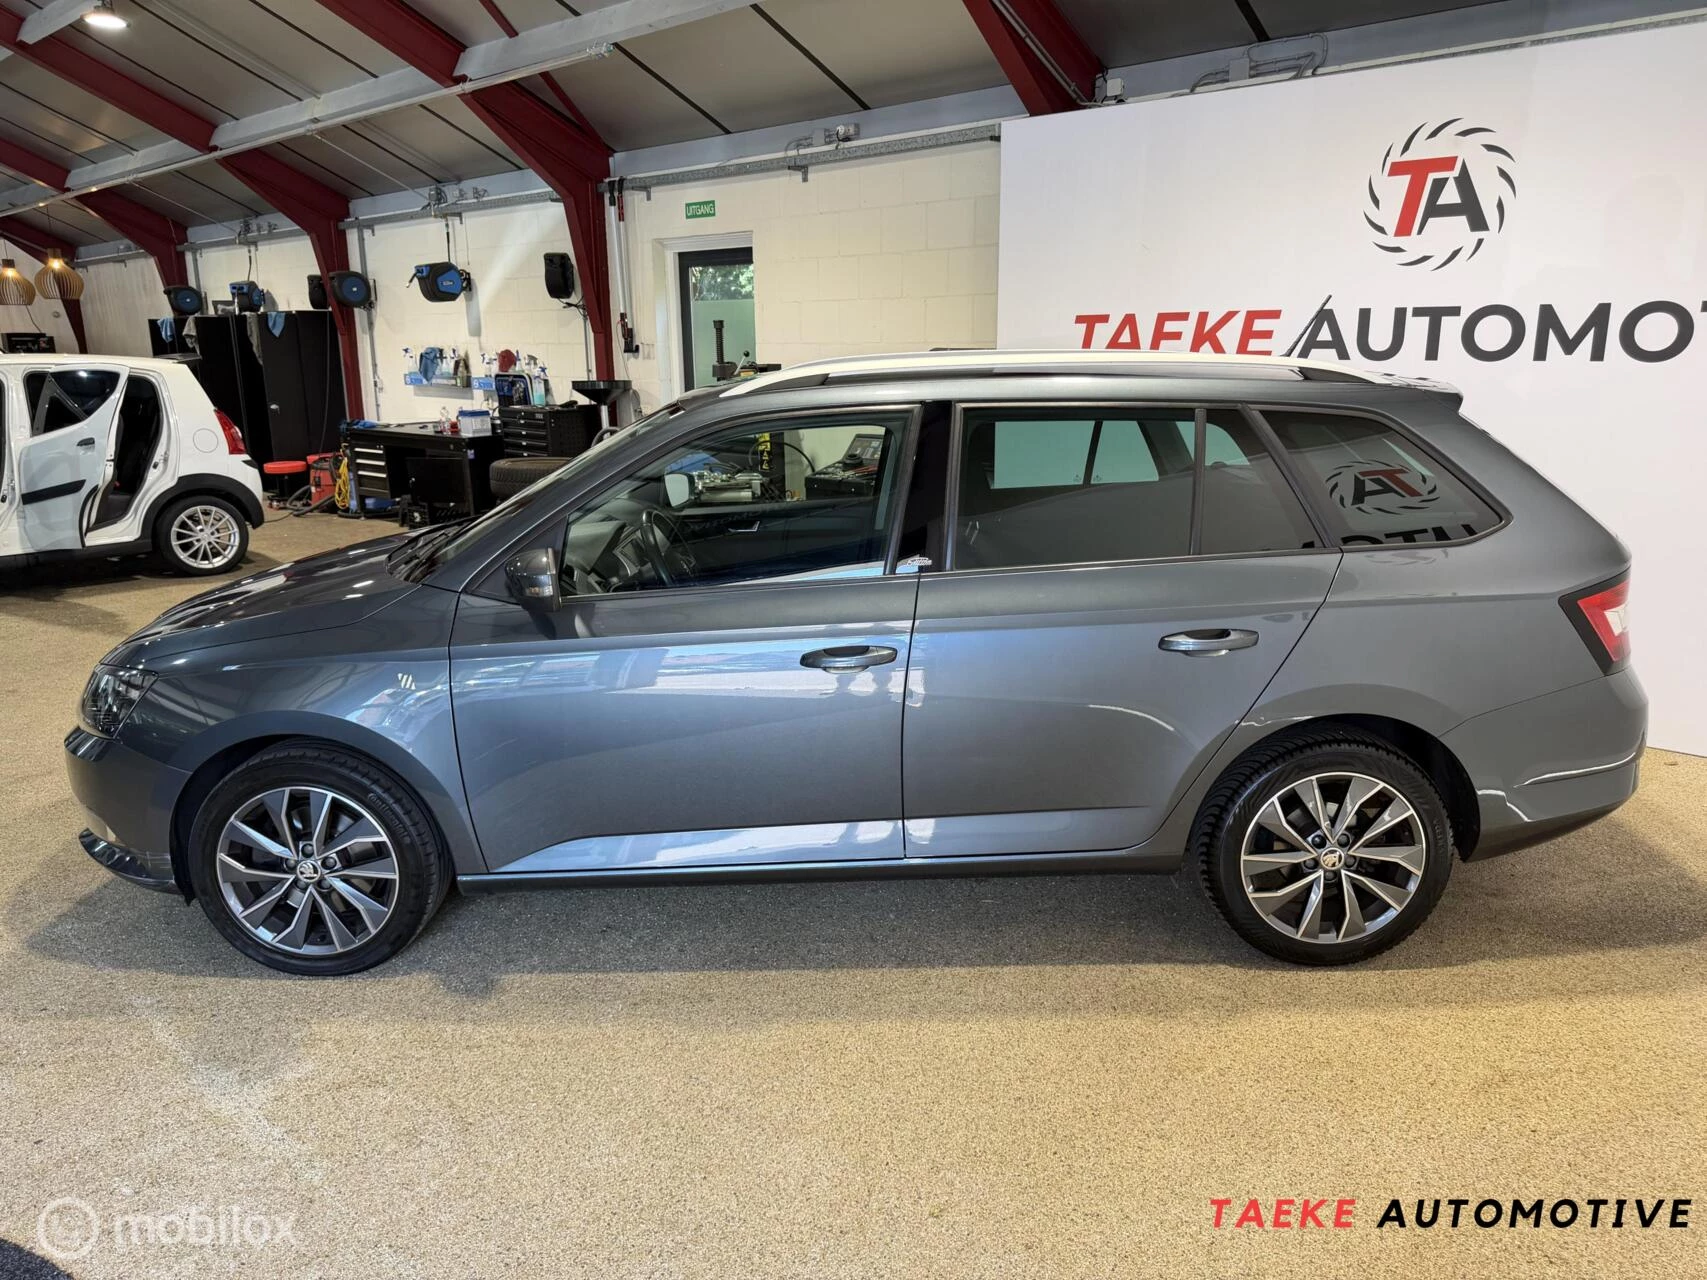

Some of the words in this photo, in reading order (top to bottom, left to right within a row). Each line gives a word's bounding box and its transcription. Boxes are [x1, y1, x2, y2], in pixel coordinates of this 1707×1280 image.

[686, 203, 715, 217] UITGANG
[1387, 155, 1490, 237] TA
[1297, 300, 1707, 363] AUTOMO
